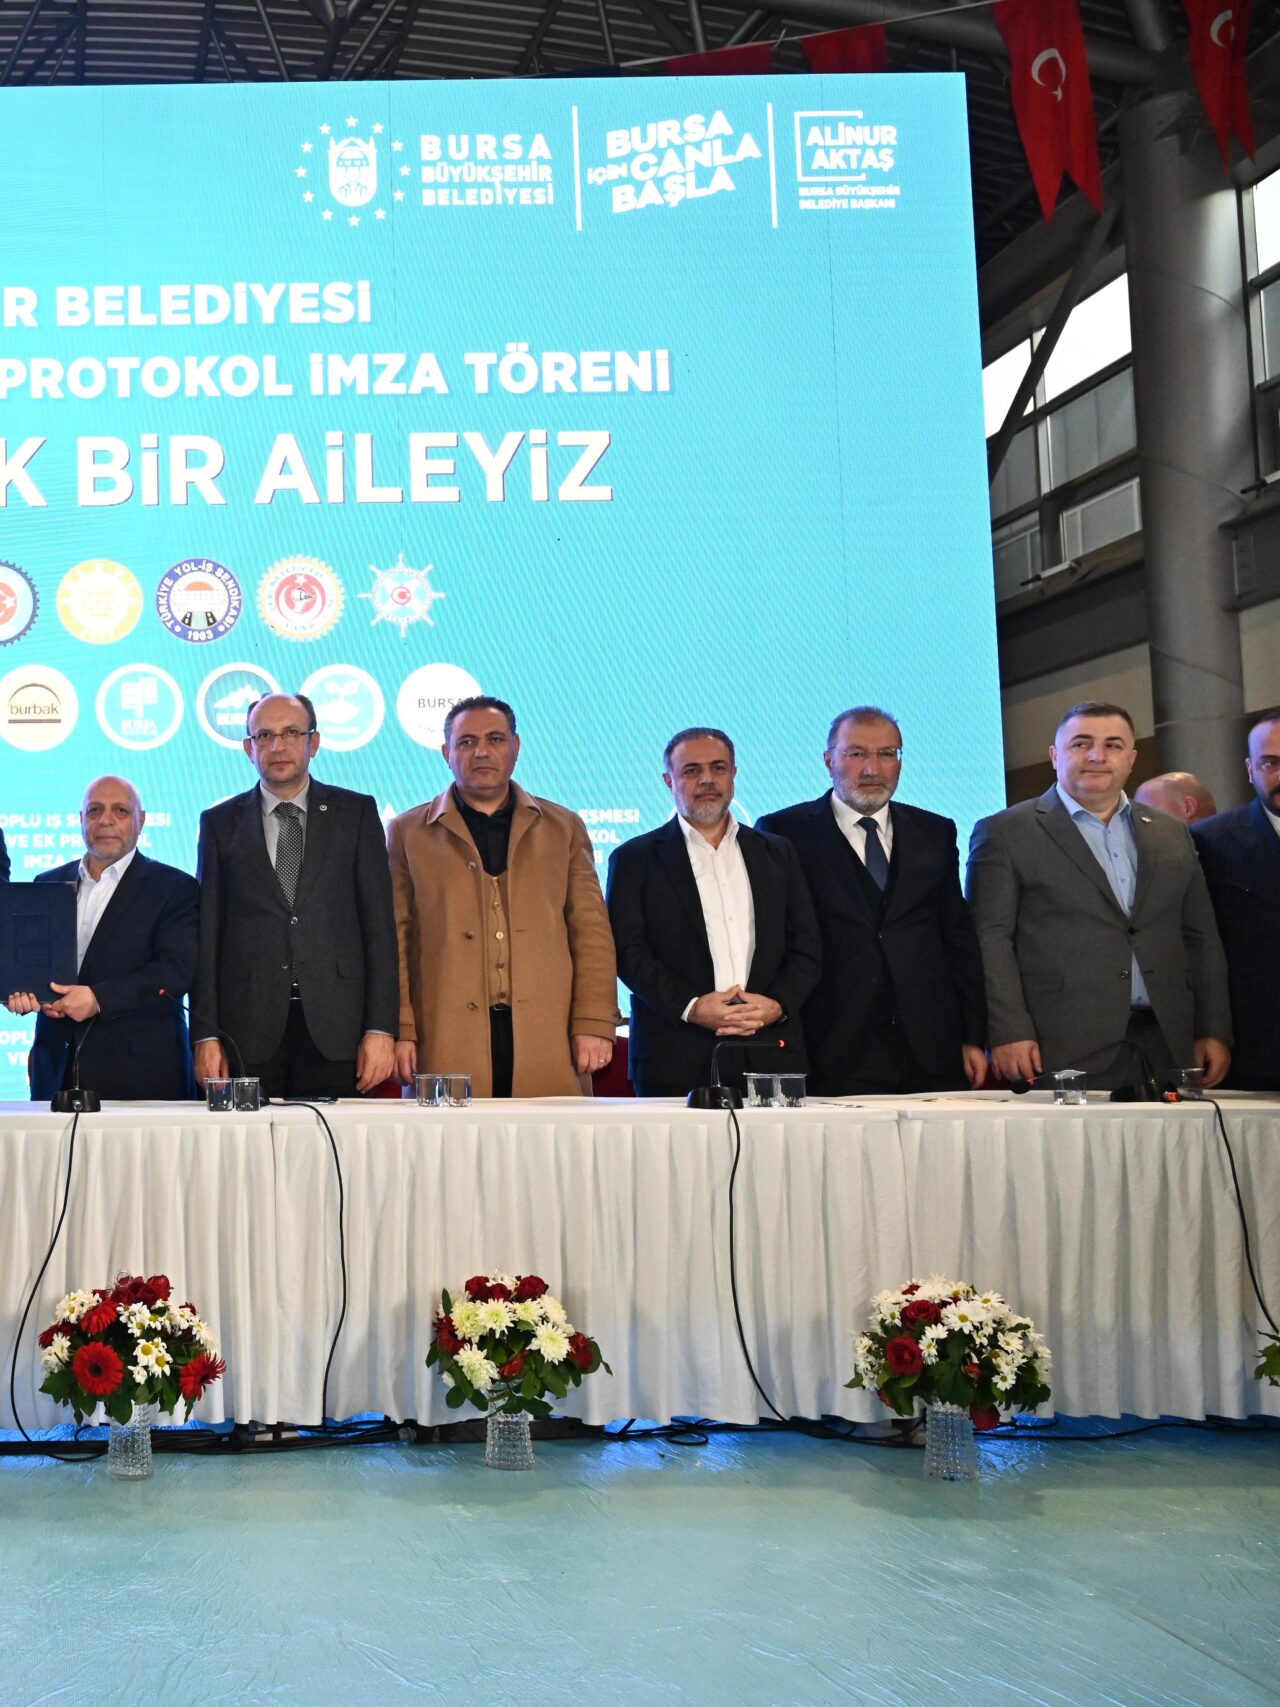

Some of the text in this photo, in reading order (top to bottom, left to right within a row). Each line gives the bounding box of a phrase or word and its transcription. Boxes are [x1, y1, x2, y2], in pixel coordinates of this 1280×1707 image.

[606, 110, 734, 158] BURSA
[806, 122, 897, 146] ALİNUR
[420, 133, 552, 160] BURSA
[630, 133, 762, 181] CANLA
[811, 148, 895, 172] AKTAŞ
[422, 160, 553, 185] BÜYÜKŞEHİR
[423, 183, 553, 206] BELEDİYESİ
[612, 166, 736, 213] BAŞLA
[799, 187, 834, 196] BURSA
[57, 281, 371, 327] BELEDİYESİ
[310, 353, 449, 396] İMZA
[464, 343, 671, 394] TÖRENİ
[187, 630, 214, 641] 1963
[10, 703, 60, 715] burbak
[5, 833, 29, 848] VE
[33, 833, 56, 848] EK
